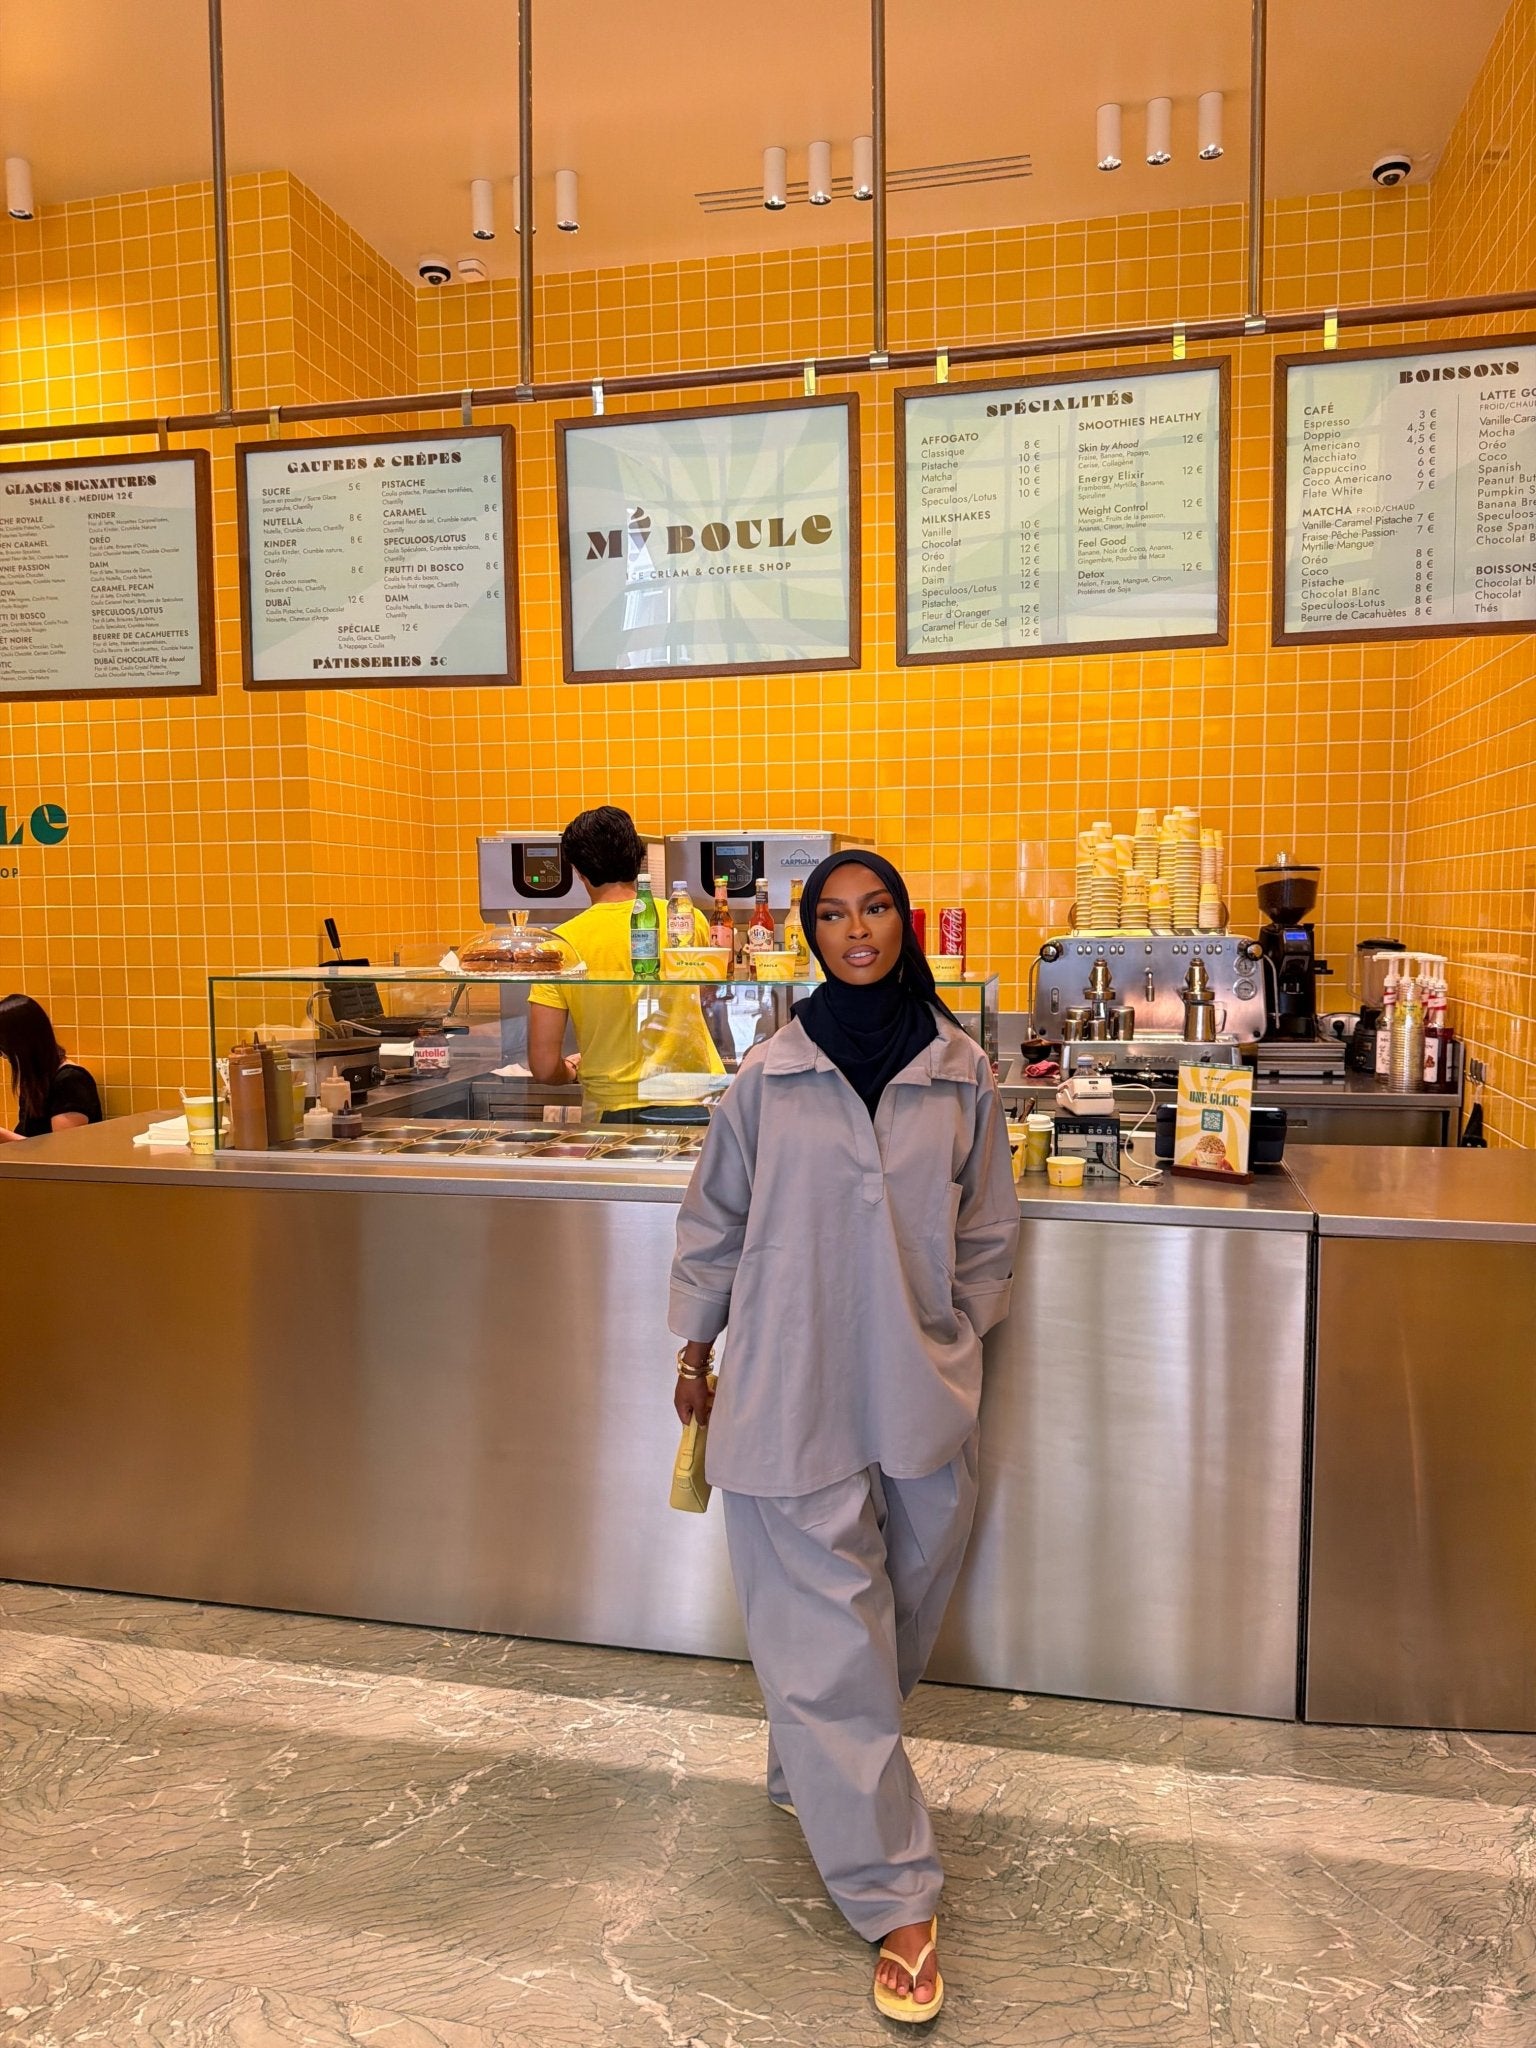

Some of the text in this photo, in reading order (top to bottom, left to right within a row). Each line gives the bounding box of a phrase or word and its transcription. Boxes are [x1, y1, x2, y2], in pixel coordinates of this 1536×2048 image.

[1399, 361, 1520, 384] BOISSONS
[1480, 389, 1517, 401] LATTE
[986, 390, 1134, 417] SPÉCIALITÉS
[1303, 402, 1334, 416] CAFÉ
[1078, 412, 1202, 431] SMOOTHIES HEALTHY
[1303, 418, 1350, 430] Espresso
[1303, 430, 1341, 441] Doppio
[1479, 427, 1515, 439] Mocha
[921, 432, 979, 446] AFFOGATO
[1182, 434, 1194, 444] 12
[1478, 439, 1507, 450] Oréo
[1078, 439, 1140, 453] Skin by Ahood
[1303, 441, 1360, 452] Americano
[921, 448, 965, 459] Classique
[1019, 453, 1030, 462] 10
[1302, 452, 1357, 464] Macchiato
[1478, 452, 1508, 462] Coco
[287, 452, 462, 474] GAUFRES & CRÊPES
[921, 460, 959, 471] Pistache
[1478, 461, 1521, 475] Spanish
[1302, 463, 1367, 476] Cappuccino
[921, 472, 953, 482] Matcha
[1078, 471, 1145, 485] Energy Elixir
[1302, 473, 1392, 487] Coco Americano
[1477, 475, 1515, 486] Peanut
[5, 475, 157, 495] GLACES SIGNATURES
[381, 479, 426, 489] PISTACHE
[921, 483, 957, 495] Caramel
[262, 487, 291, 497] SUCRE
[1302, 486, 1363, 499] Flate White
[1477, 486, 1524, 499] Pumpkin
[29, 497, 57, 506] SMALL
[79, 493, 114, 502] MEDIUM
[921, 492, 997, 508] Speculoos/Lotus
[1477, 500, 1517, 510] Banana
[383, 508, 427, 518] CARAMEL
[1078, 502, 1149, 517] Weight Control
[1302, 503, 1416, 517] MATCHA FROID/CHAUD
[16, 516, 44, 524] ROYALE
[88, 511, 116, 520] KINDER
[921, 511, 991, 525] MILKSHAKES
[263, 517, 303, 527] NUTELLA
[921, 527, 952, 537] Vanille
[1476, 523, 1503, 533] Rose
[14, 540, 49, 549] CARAMEL
[263, 539, 297, 549] KINDER
[383, 534, 467, 546] SPECULOOS/LOTUS
[921, 538, 962, 549] Chocolat
[1078, 536, 1127, 548] Feel Good
[1476, 533, 1525, 546] Chocolat
[921, 550, 945, 561] Oréo
[1301, 554, 1328, 565] Oréo
[18, 564, 50, 572] PASSION
[89, 561, 109, 569] DAIM
[384, 563, 464, 574] FRUTTI DI BOSCO
[695, 567, 703, 577] &
[708, 564, 753, 575] COFFEE
[759, 562, 792, 572] SHOP
[921, 563, 952, 573] Kinder
[264, 569, 286, 578] Oréo
[1078, 570, 1105, 580] Detox
[1301, 567, 1329, 577] Coco
[921, 576, 945, 585] Daim
[1301, 577, 1345, 588] Pistache
[1475, 576, 1522, 588] Chocolat
[91, 583, 154, 593] CARAMEL PECAN
[921, 584, 997, 599] Speculoos/Lotus
[1301, 586, 1380, 600] Chocolat Blanc
[385, 594, 409, 602] DAIM
[1475, 589, 1522, 600] Chocolat
[265, 597, 291, 607] DUBAÏ
[921, 598, 959, 608] Pistache,
[91, 606, 164, 617] SPECULOOS/LOTUS
[1475, 603, 1498, 613] Thés
[20, 612, 46, 620] BOSCO
[921, 611, 943, 621] Fleur
[1301, 608, 1407, 622] Beurre de Cacahuètes
[337, 623, 380, 633] SPÉCIALE
[921, 617, 1008, 632] Caramel Fleur de Sel
[9, 636, 33, 644] NOIRE
[92, 632, 121, 641] BEURRE
[135, 630, 189, 639] CACAHUETTES
[921, 634, 954, 644] Matcha
[116, 655, 160, 664] CHOCOLATE
[313, 656, 422, 670] PÂTISSERIES
[669, 920, 690, 928] evian
[414, 1048, 446, 1058] nutella
